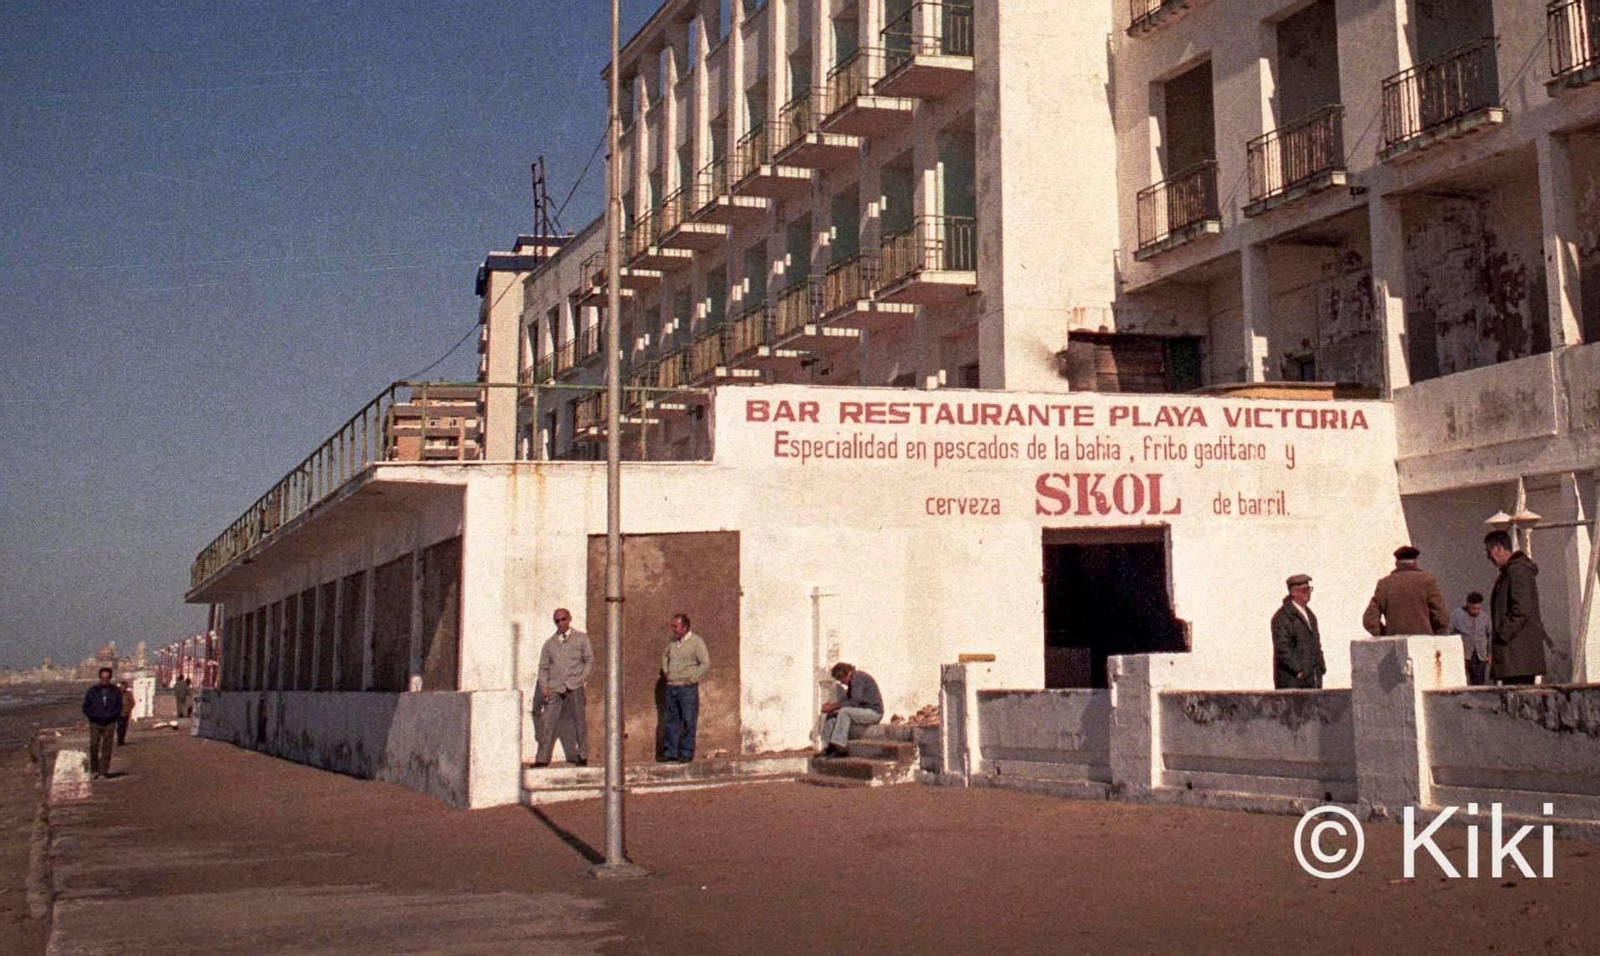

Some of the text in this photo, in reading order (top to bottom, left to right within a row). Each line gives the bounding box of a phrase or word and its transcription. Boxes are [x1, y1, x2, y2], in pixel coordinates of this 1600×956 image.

[745, 400, 1369, 430] BAR RESTAURANTE PLAYA VICTORIA
[774, 430, 898, 465] Especialidad
[906, 440, 926, 460] en
[934, 434, 1019, 467] pescados
[1027, 434, 1047, 460] de
[1055, 434, 1070, 460] la
[1143, 434, 1188, 461] frito
[1194, 434, 1266, 469] gaditano
[1285, 444, 1296, 469] y
[926, 473, 1290, 517] cerveza SKOL de barril.
